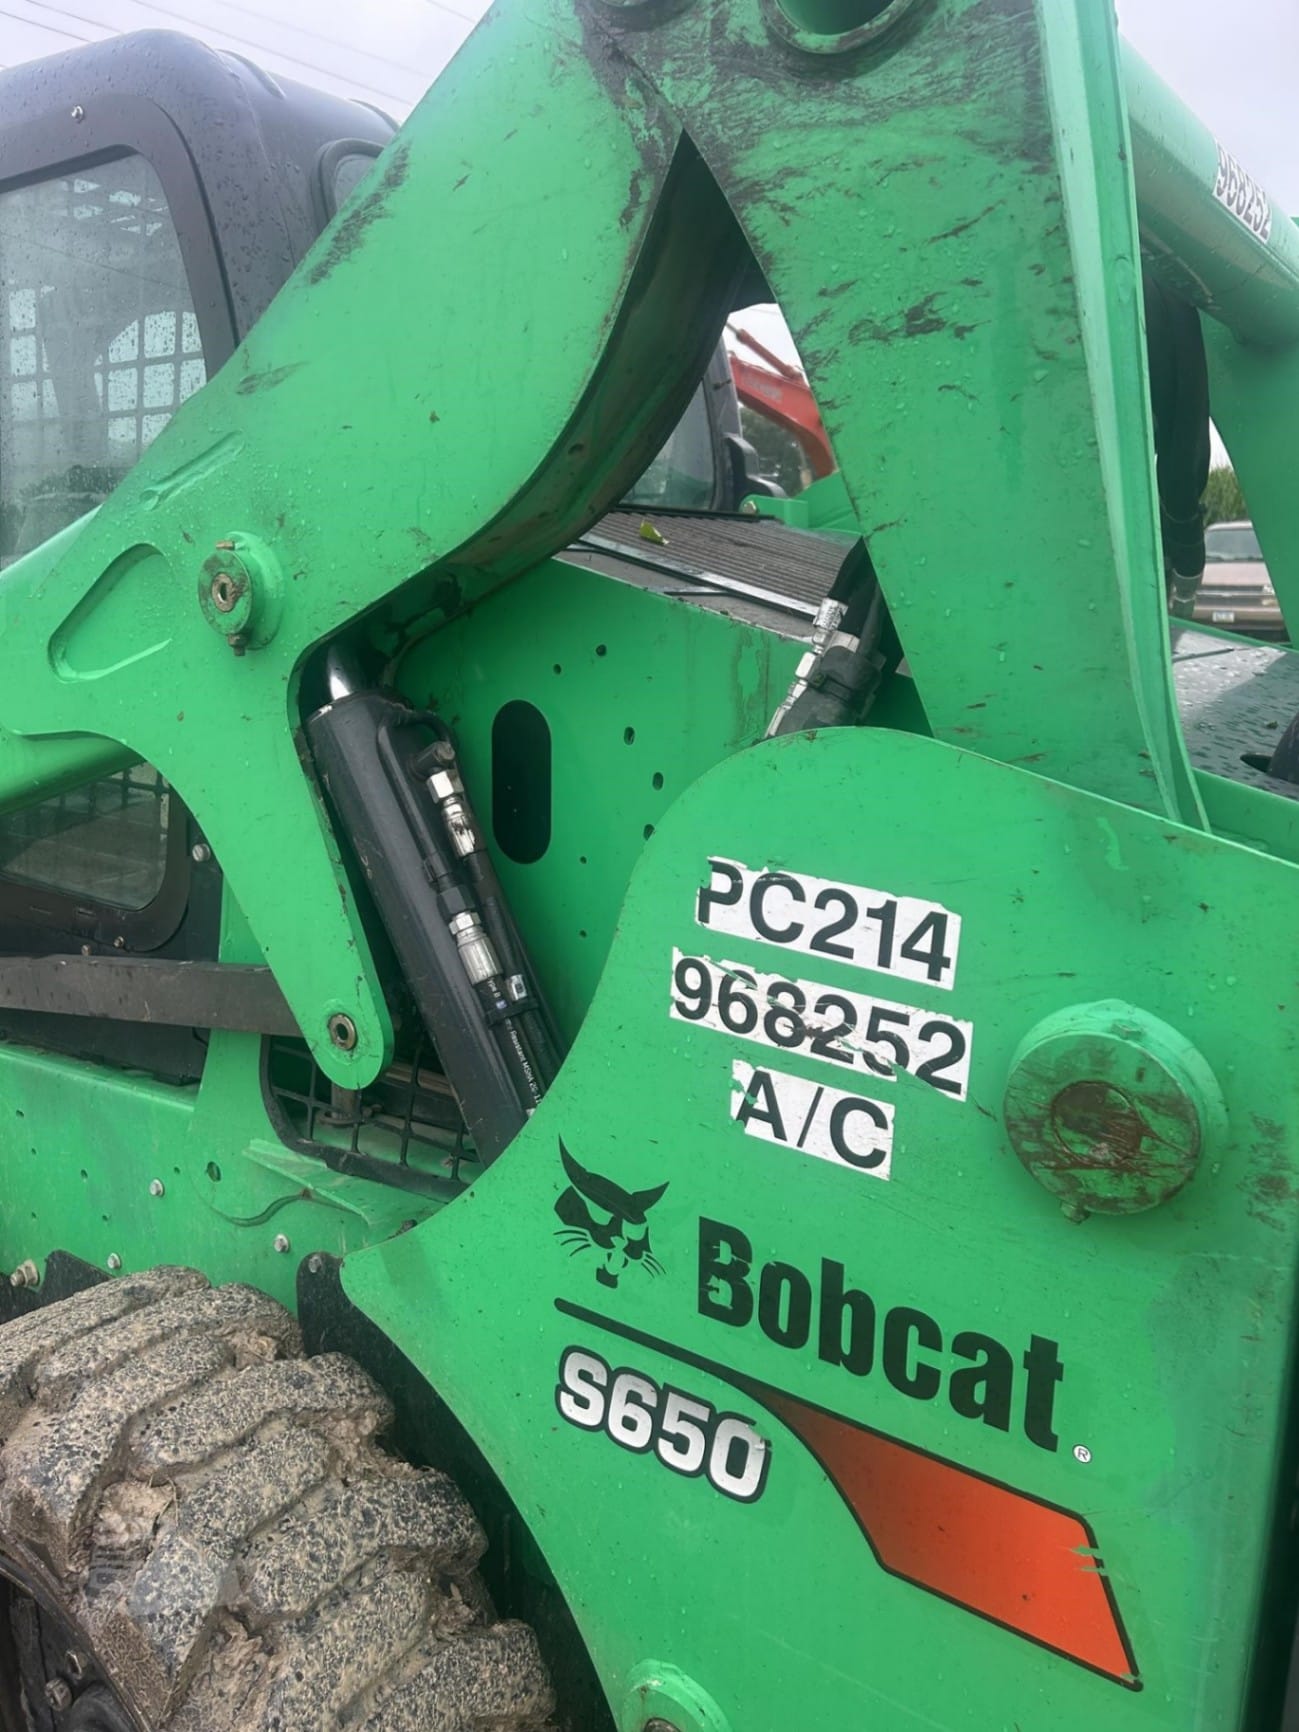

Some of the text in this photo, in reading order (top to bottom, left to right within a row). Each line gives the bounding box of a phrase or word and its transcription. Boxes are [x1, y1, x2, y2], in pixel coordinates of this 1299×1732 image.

[1216, 142, 1271, 241] 968252
[697, 860, 951, 982] PC214
[674, 957, 966, 1096] 968252
[735, 1070, 889, 1170] A/C
[698, 1216, 1064, 1453] Bobcat
[555, 1345, 773, 1504] S650
